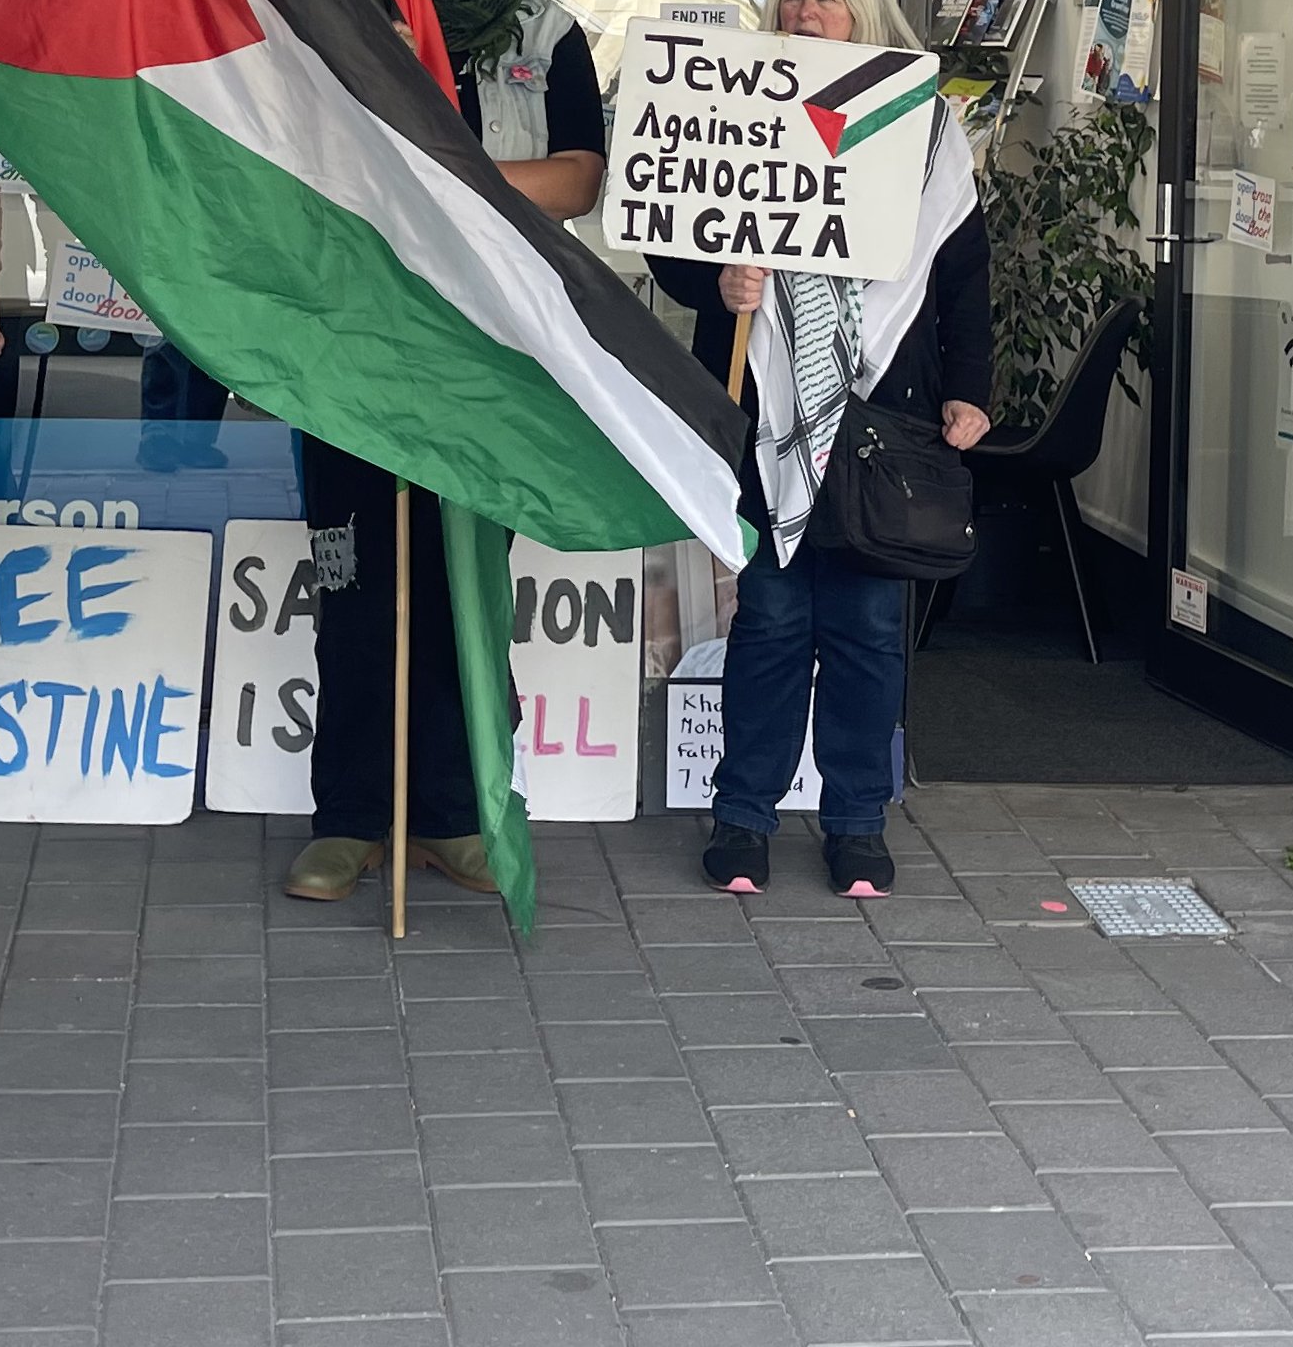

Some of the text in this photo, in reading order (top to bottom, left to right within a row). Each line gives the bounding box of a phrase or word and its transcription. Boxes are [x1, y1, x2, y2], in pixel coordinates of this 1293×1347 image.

[672, 10, 726, 24] END THE
[644, 33, 800, 103] Jews
[633, 101, 787, 154] Against
[625, 152, 848, 206] GENOCIDE
[620, 199, 851, 260] IN GAZA
[68, 254, 106, 272] ope
[65, 271, 76, 283] a
[62, 287, 106, 305] door
[683, 692, 723, 713] Kha
[681, 716, 725, 735] Moha
